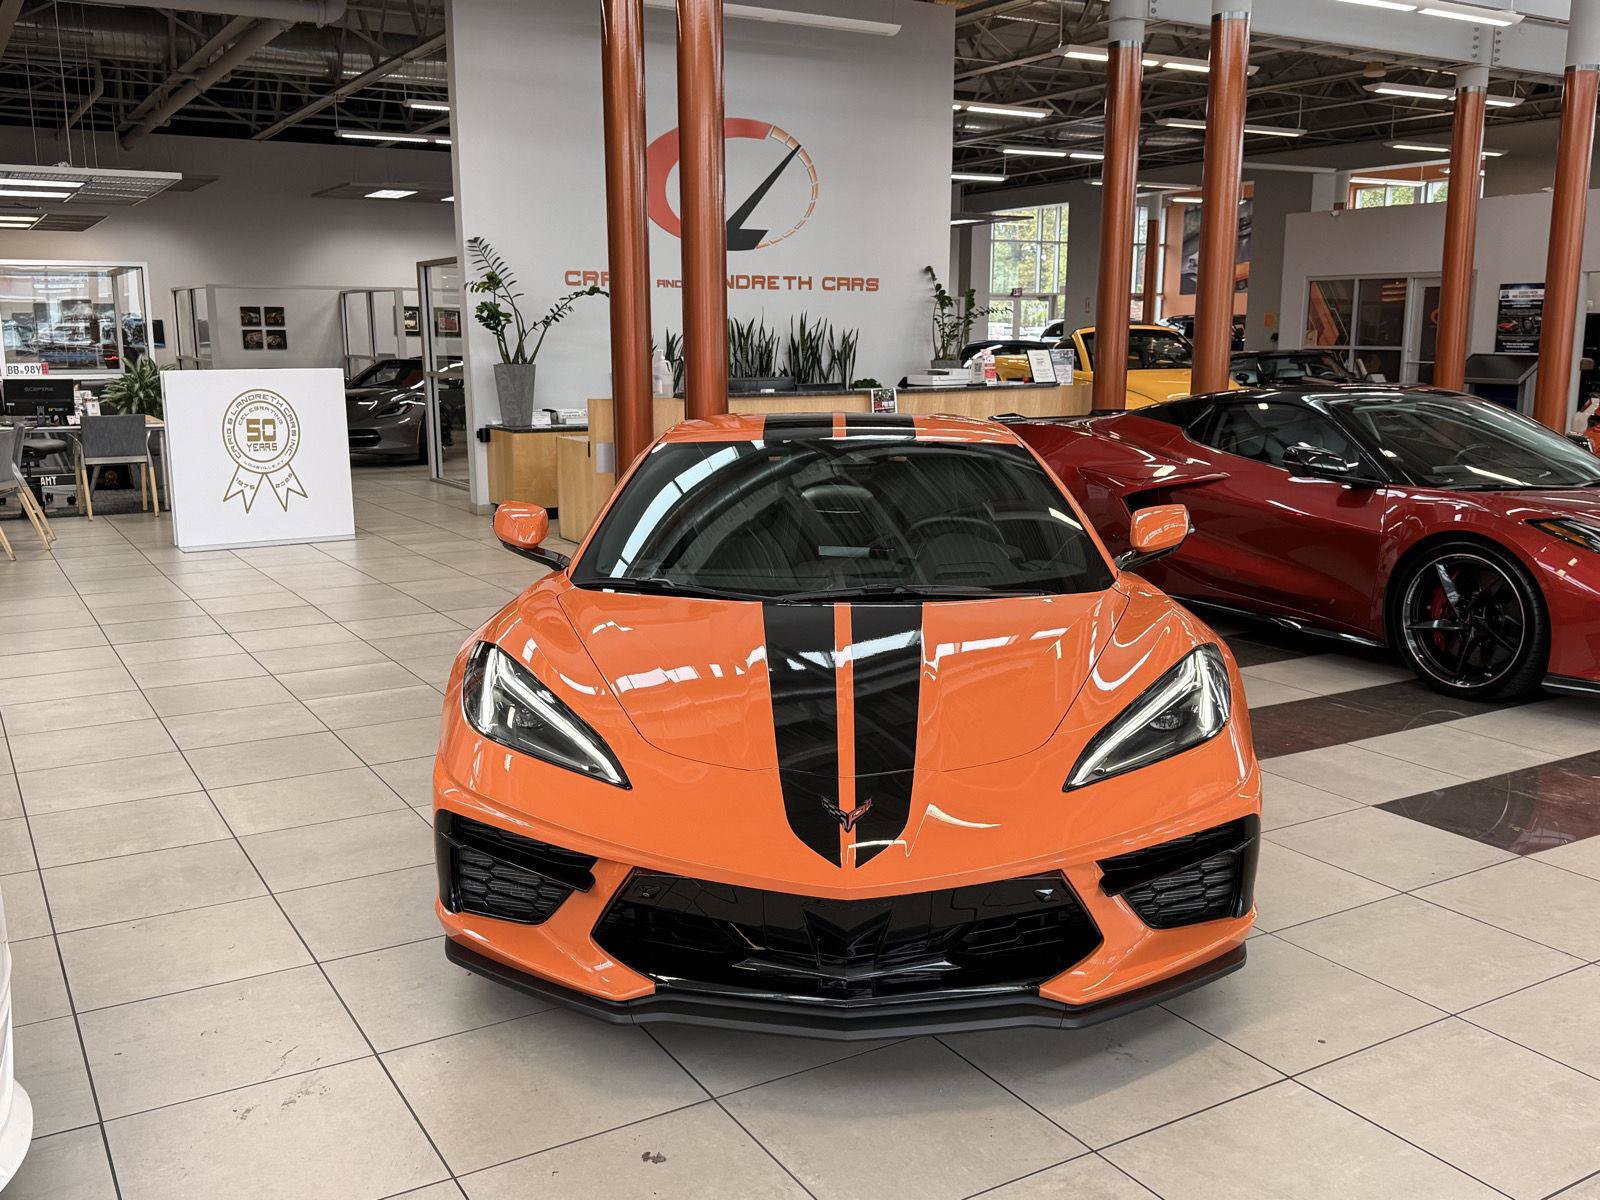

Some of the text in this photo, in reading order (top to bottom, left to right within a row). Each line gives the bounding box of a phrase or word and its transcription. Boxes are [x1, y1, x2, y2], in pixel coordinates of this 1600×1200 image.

[727, 274, 812, 291] NDRETH
[821, 276, 880, 292] CARS
[231, 393, 284, 416] LANDRETH
[238, 405, 284, 426] CELEBRATING
[283, 407, 297, 437] CARS
[246, 418, 277, 442] 50
[226, 428, 242, 459] CRAIG
[246, 442, 278, 452] YEARS
[40, 476, 57, 486] AMT
[235, 477, 255, 490] 1975
